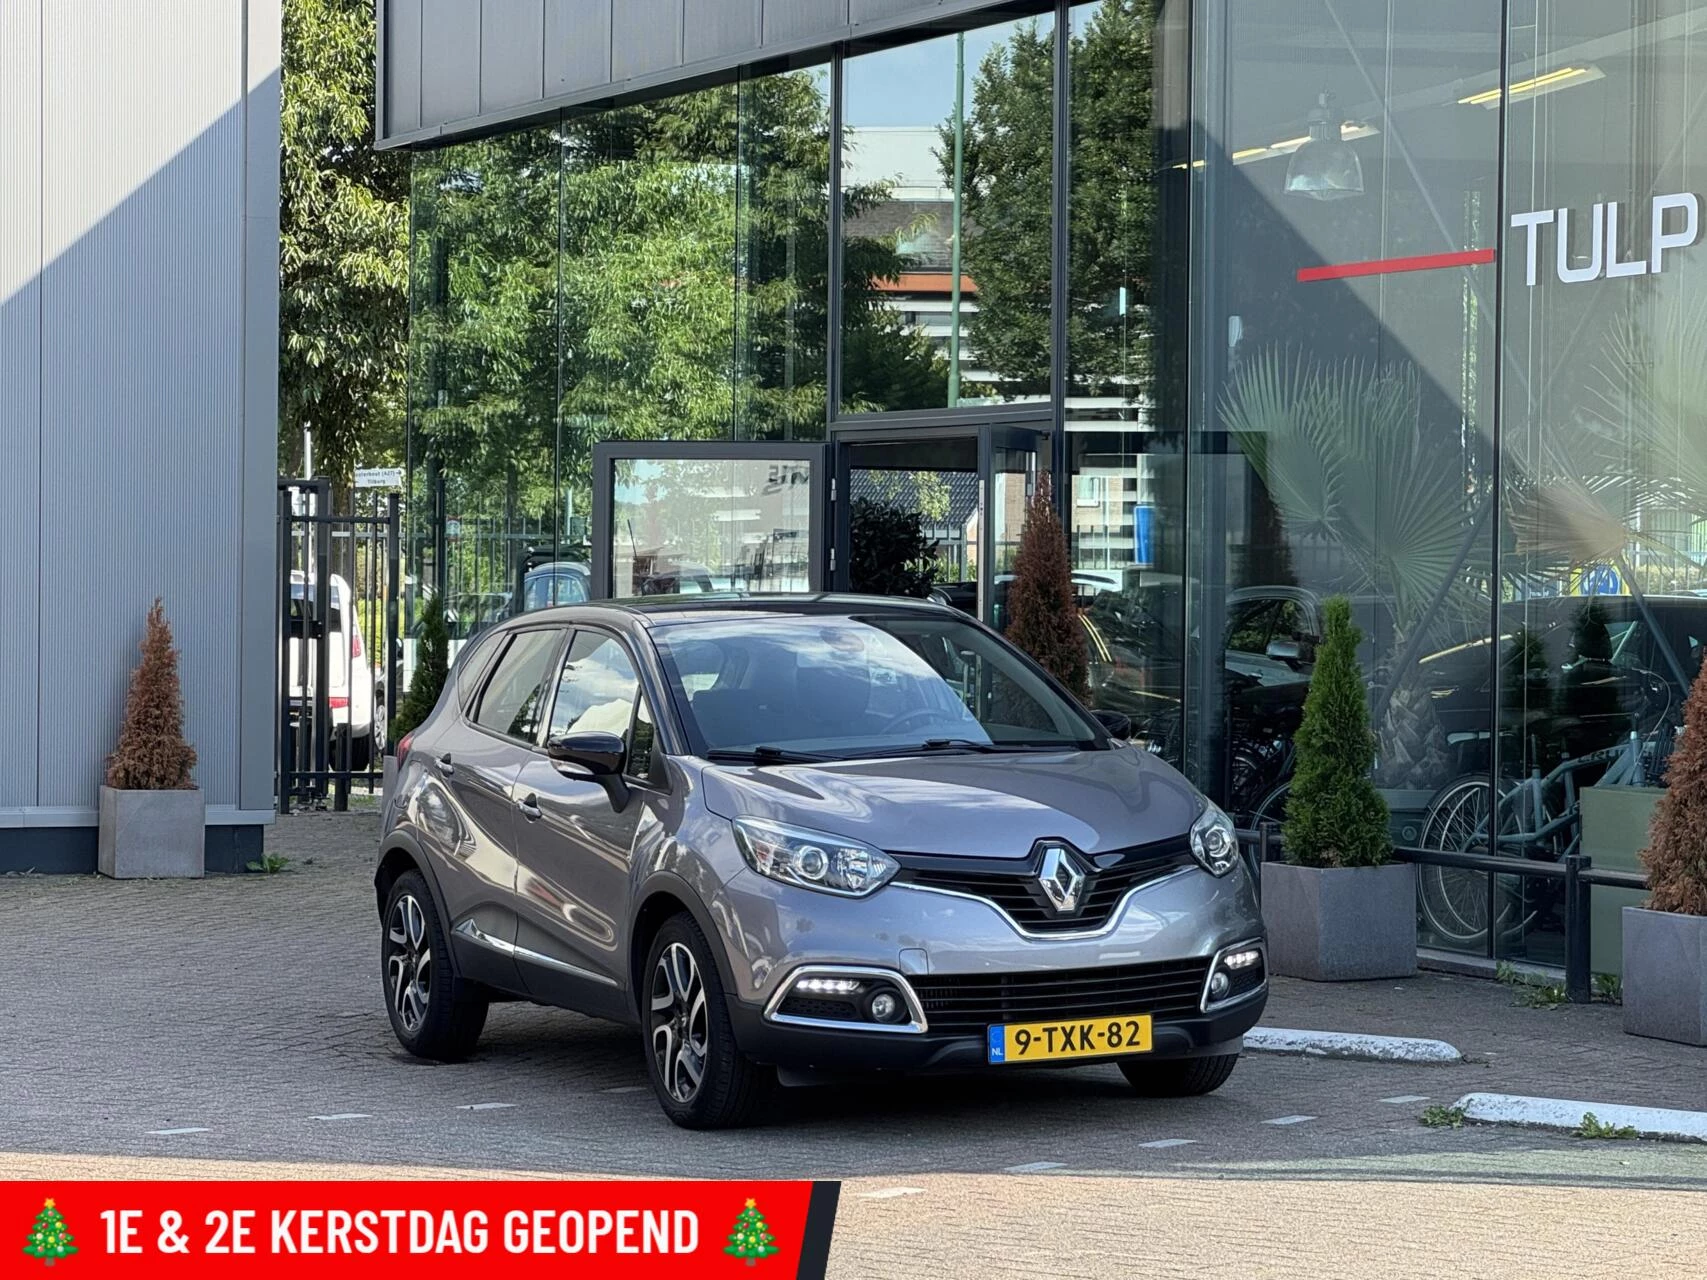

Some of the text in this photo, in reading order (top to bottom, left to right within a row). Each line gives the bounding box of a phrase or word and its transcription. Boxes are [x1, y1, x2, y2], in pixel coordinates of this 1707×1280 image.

[1510, 192, 1699, 286] TULP
[991, 1020, 1141, 1056] NL 9-TXK-82
